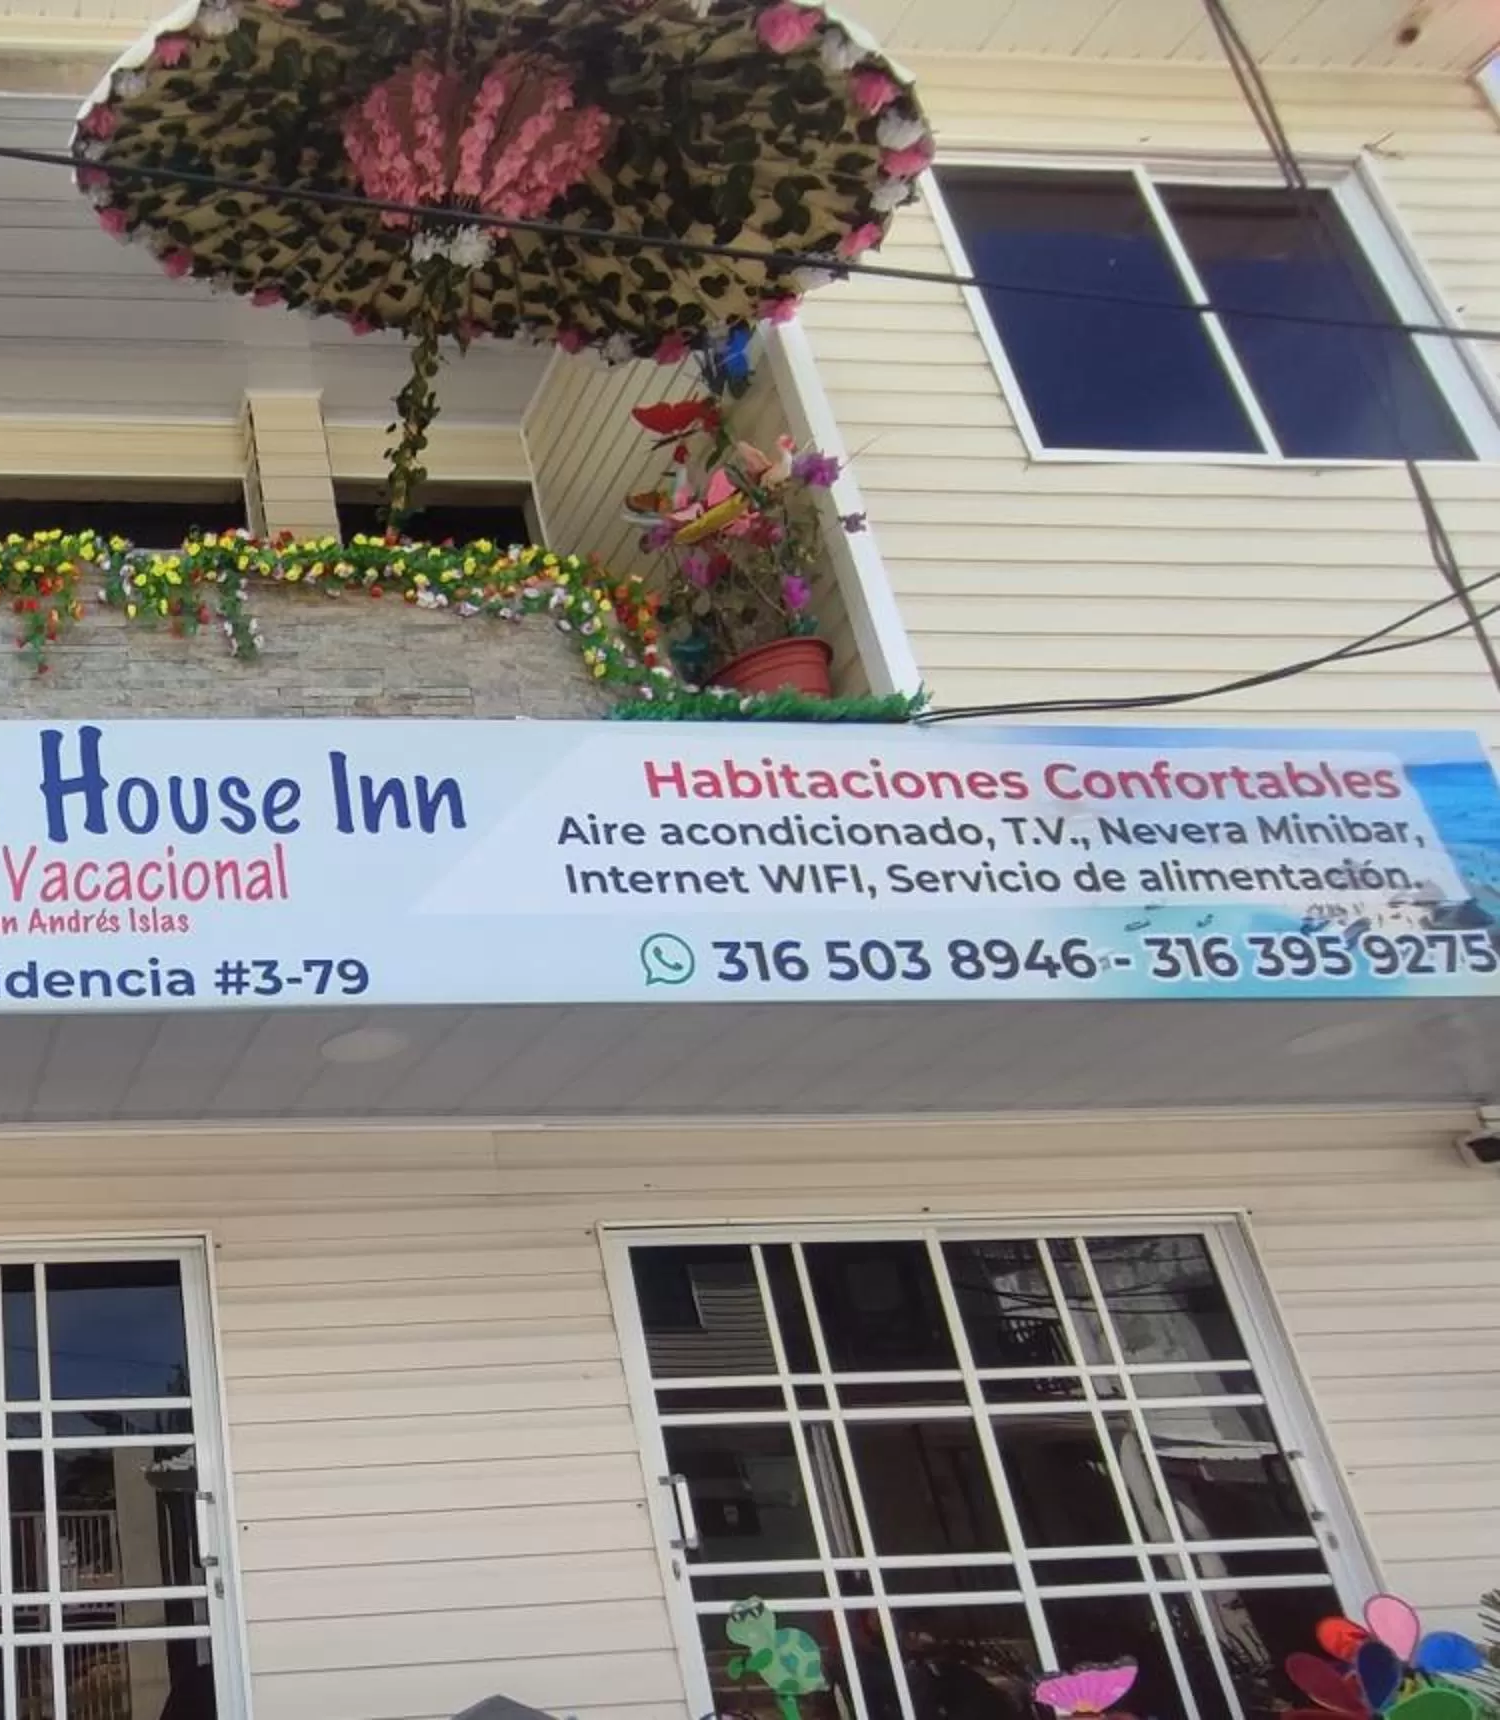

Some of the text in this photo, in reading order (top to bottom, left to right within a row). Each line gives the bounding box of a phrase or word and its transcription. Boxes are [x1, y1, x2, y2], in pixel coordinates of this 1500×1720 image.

[39, 725, 301, 843] House
[330, 750, 467, 835] Inn
[643, 758, 1401, 800] Habitaciones Confortables
[557, 813, 1425, 850] Aire acondicionado, T.V., Nevera Minibar,
[2, 843, 289, 903] Vacacional
[565, 858, 1422, 898] Internet WIFI, Servicio de alimentación.
[28, 907, 121, 934] Andrés
[129, 907, 190, 933] Islas
[214, 958, 370, 997] #3-79
[711, 940, 809, 982] 316
[825, 939, 931, 981] 503
[947, 937, 1097, 981] 8946
[1144, 937, 1237, 979] 316
[1247, 935, 1352, 976] 395
[1363, 933, 1497, 974] 9275
